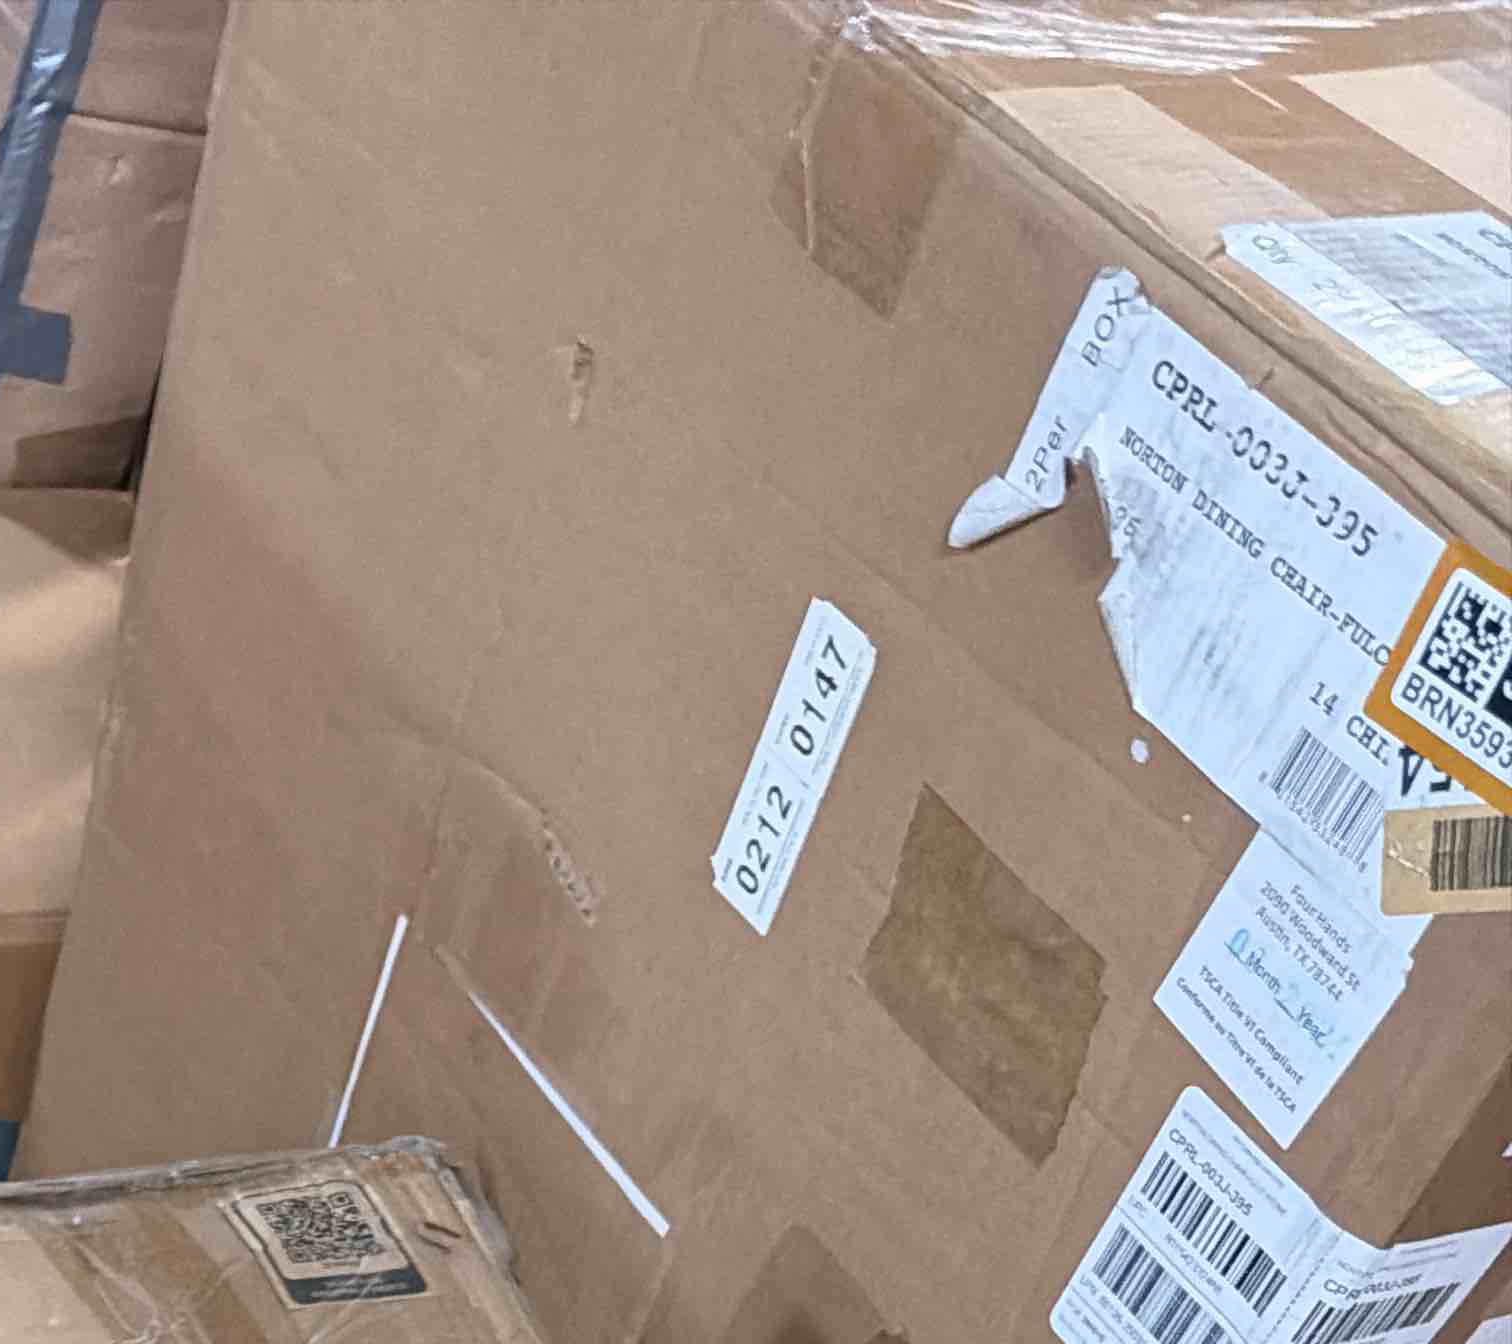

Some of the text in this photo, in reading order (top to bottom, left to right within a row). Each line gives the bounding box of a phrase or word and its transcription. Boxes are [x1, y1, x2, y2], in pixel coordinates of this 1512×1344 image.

[1119, 426, 1188, 496] NORTON
[1192, 483, 1265, 561] DINING
[735, 634, 842, 897] 0212 0147
[1292, 945, 1310, 968] TX
